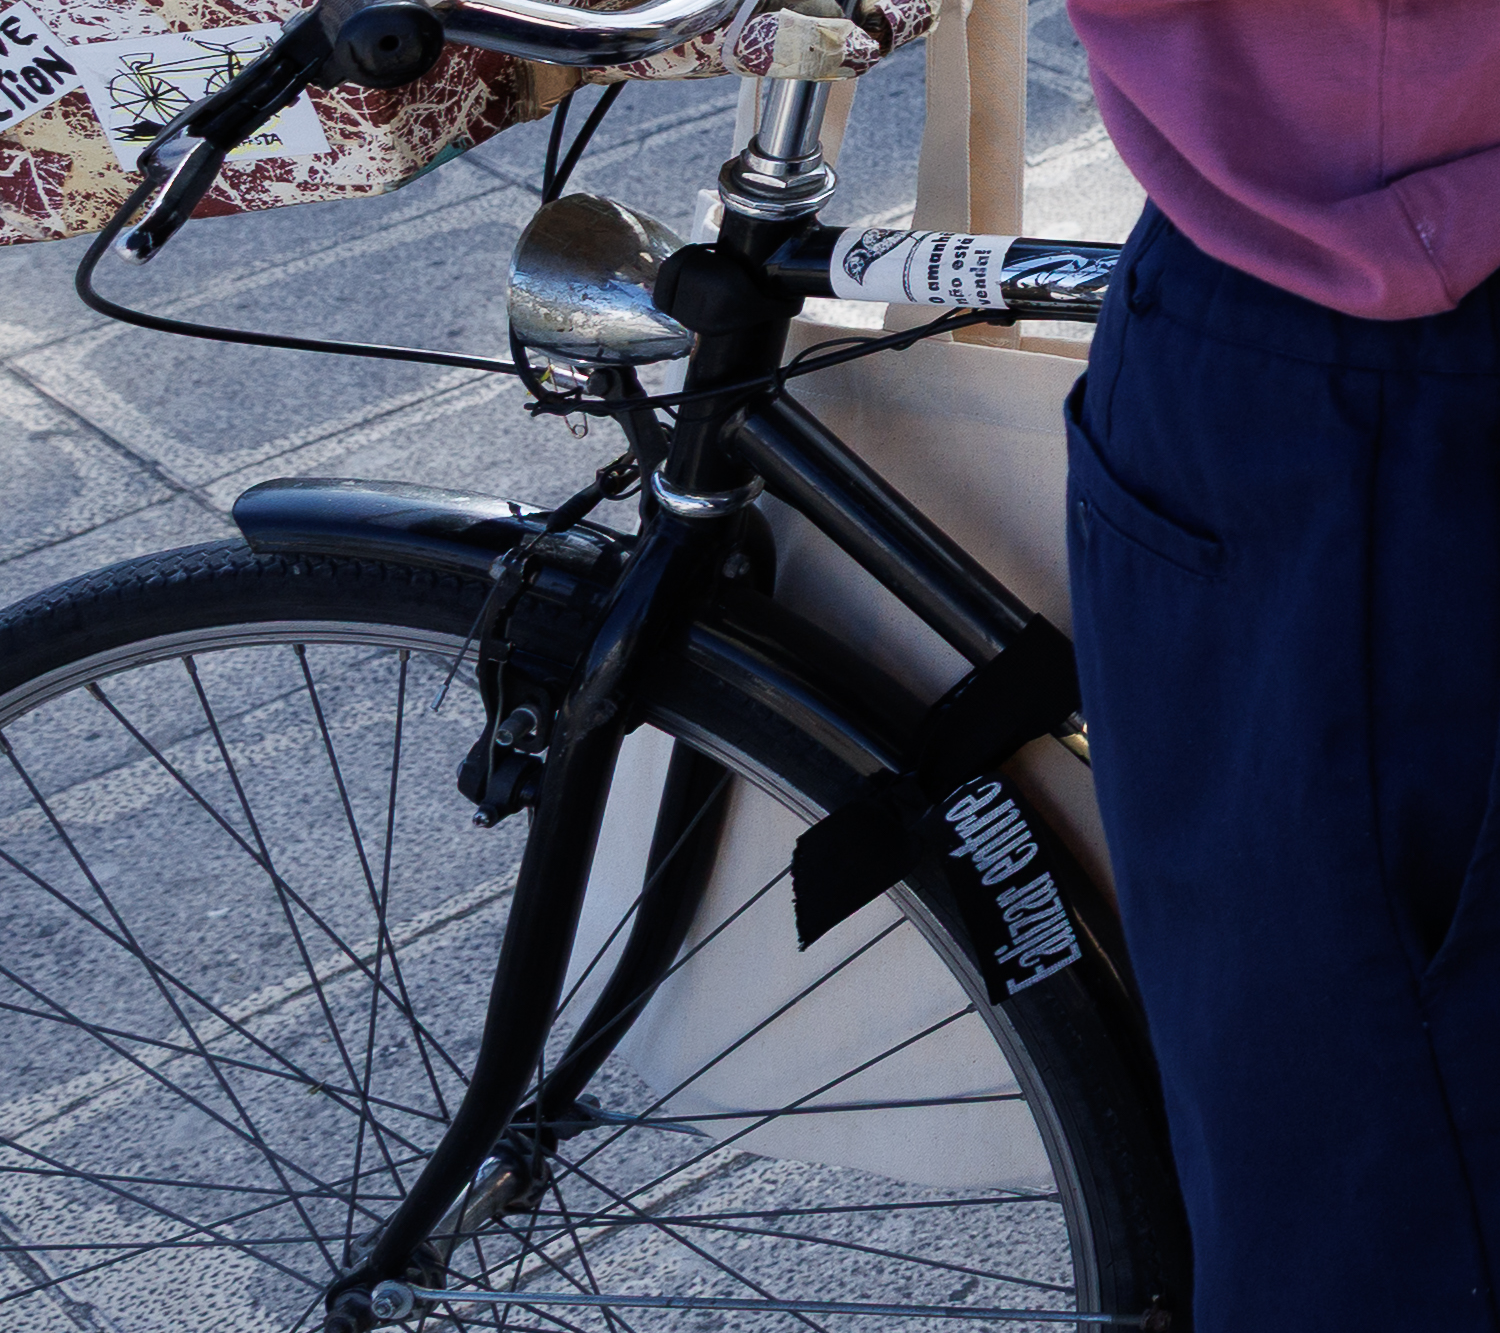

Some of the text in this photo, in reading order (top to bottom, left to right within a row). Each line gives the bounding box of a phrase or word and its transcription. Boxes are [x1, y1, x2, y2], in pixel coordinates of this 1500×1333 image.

[952, 238, 975, 270] está
[969, 249, 992, 305] venda!
[928, 296, 945, 304] O
[945, 781, 1039, 886] entre
